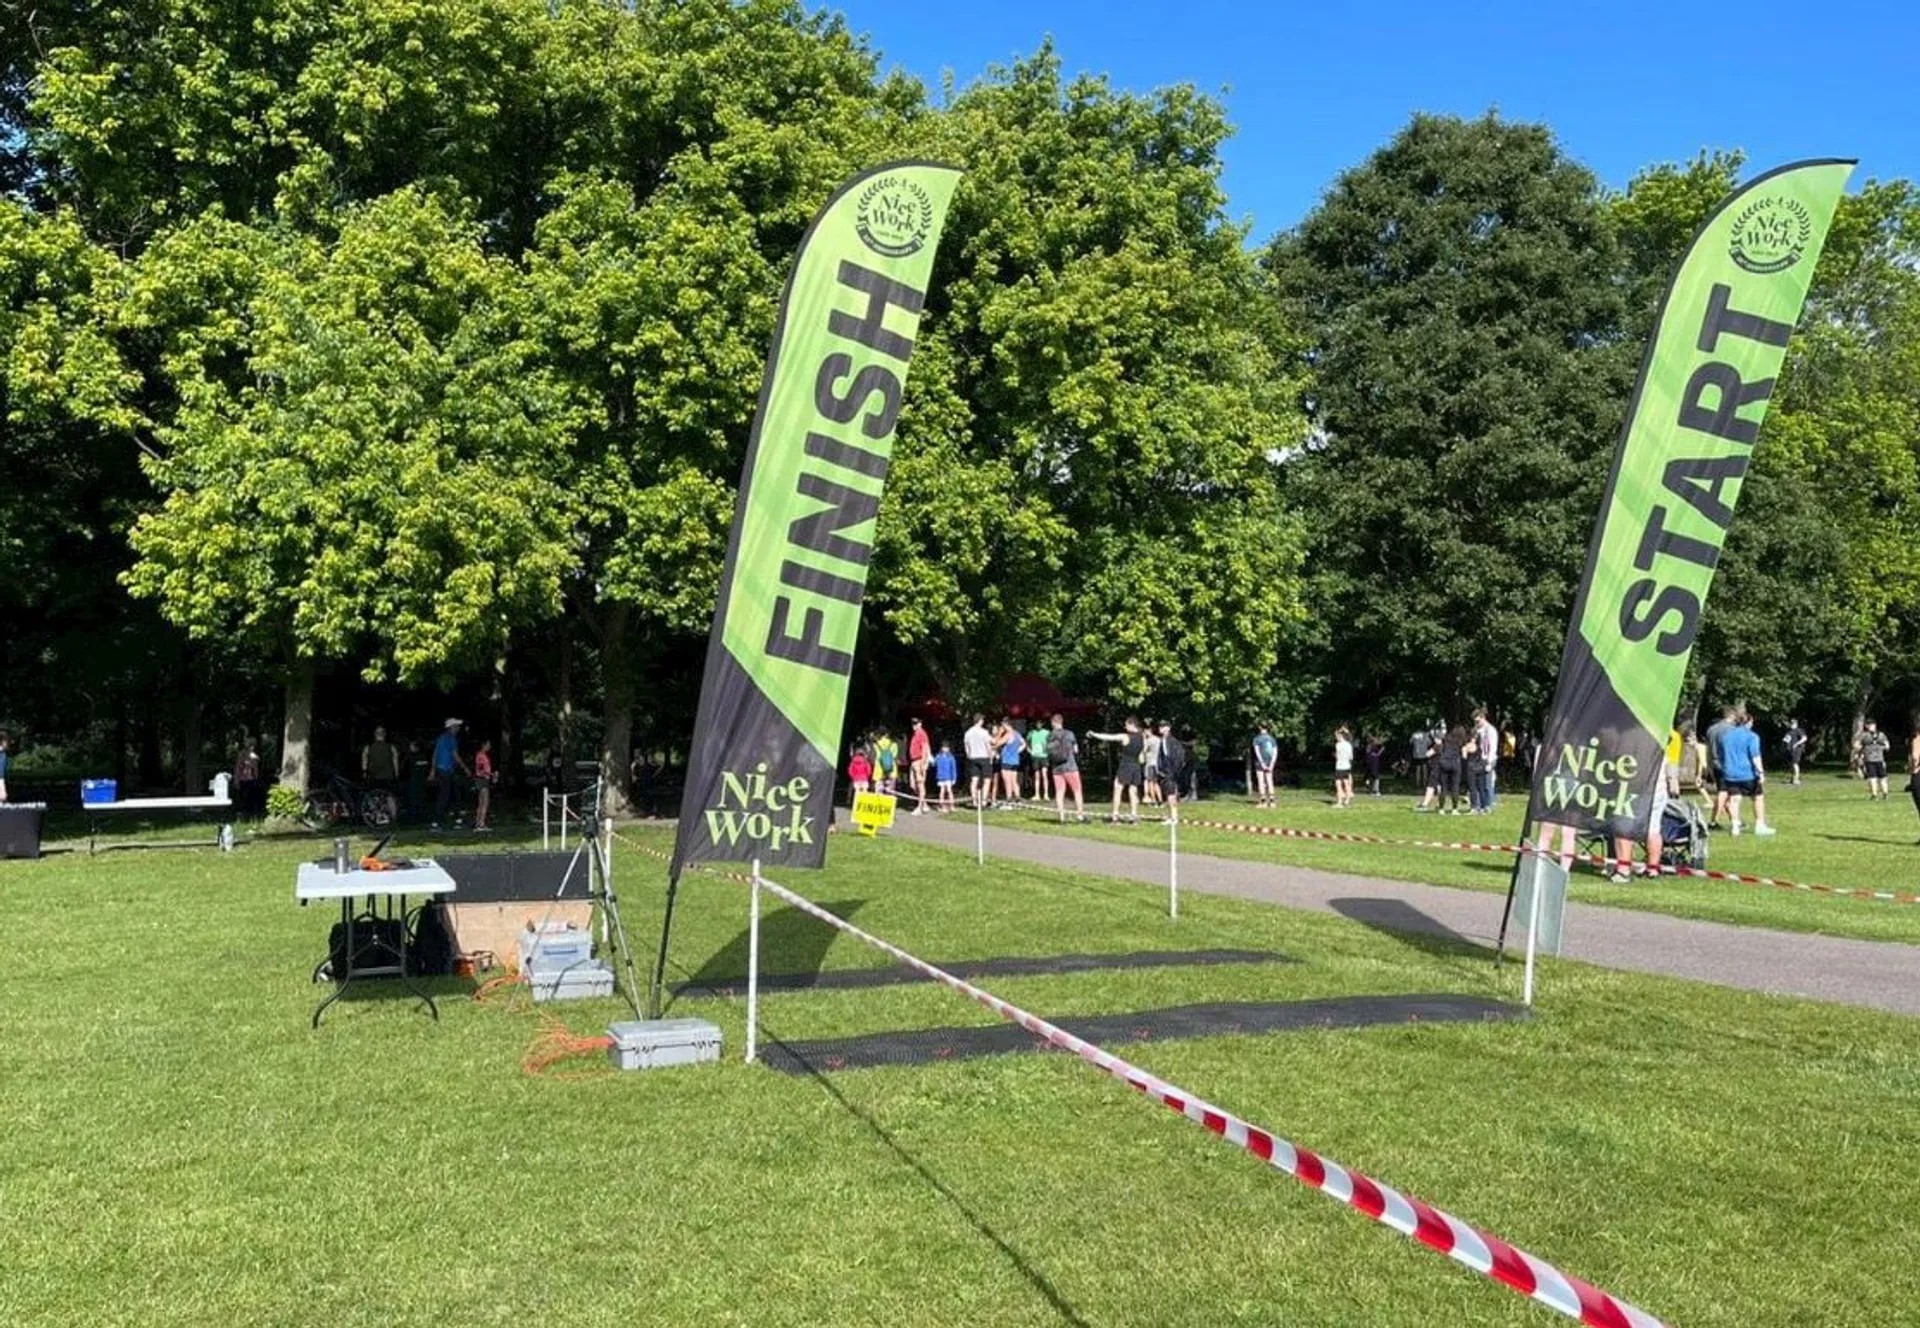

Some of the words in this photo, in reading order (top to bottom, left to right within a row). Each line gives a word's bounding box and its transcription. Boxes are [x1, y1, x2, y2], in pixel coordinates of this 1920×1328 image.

[873, 209, 914, 232] Work
[879, 193, 916, 215] Nice
[1754, 212, 1793, 232] Nice
[1747, 230, 1791, 248] Work
[764, 259, 925, 676] FINISH
[1619, 282, 1794, 657] START
[1553, 737, 1638, 784] Nice
[717, 762, 810, 811] Nice
[856, 798, 892, 816] FINISH
[1543, 776, 1638, 820] Work
[704, 804, 815, 851] Work
